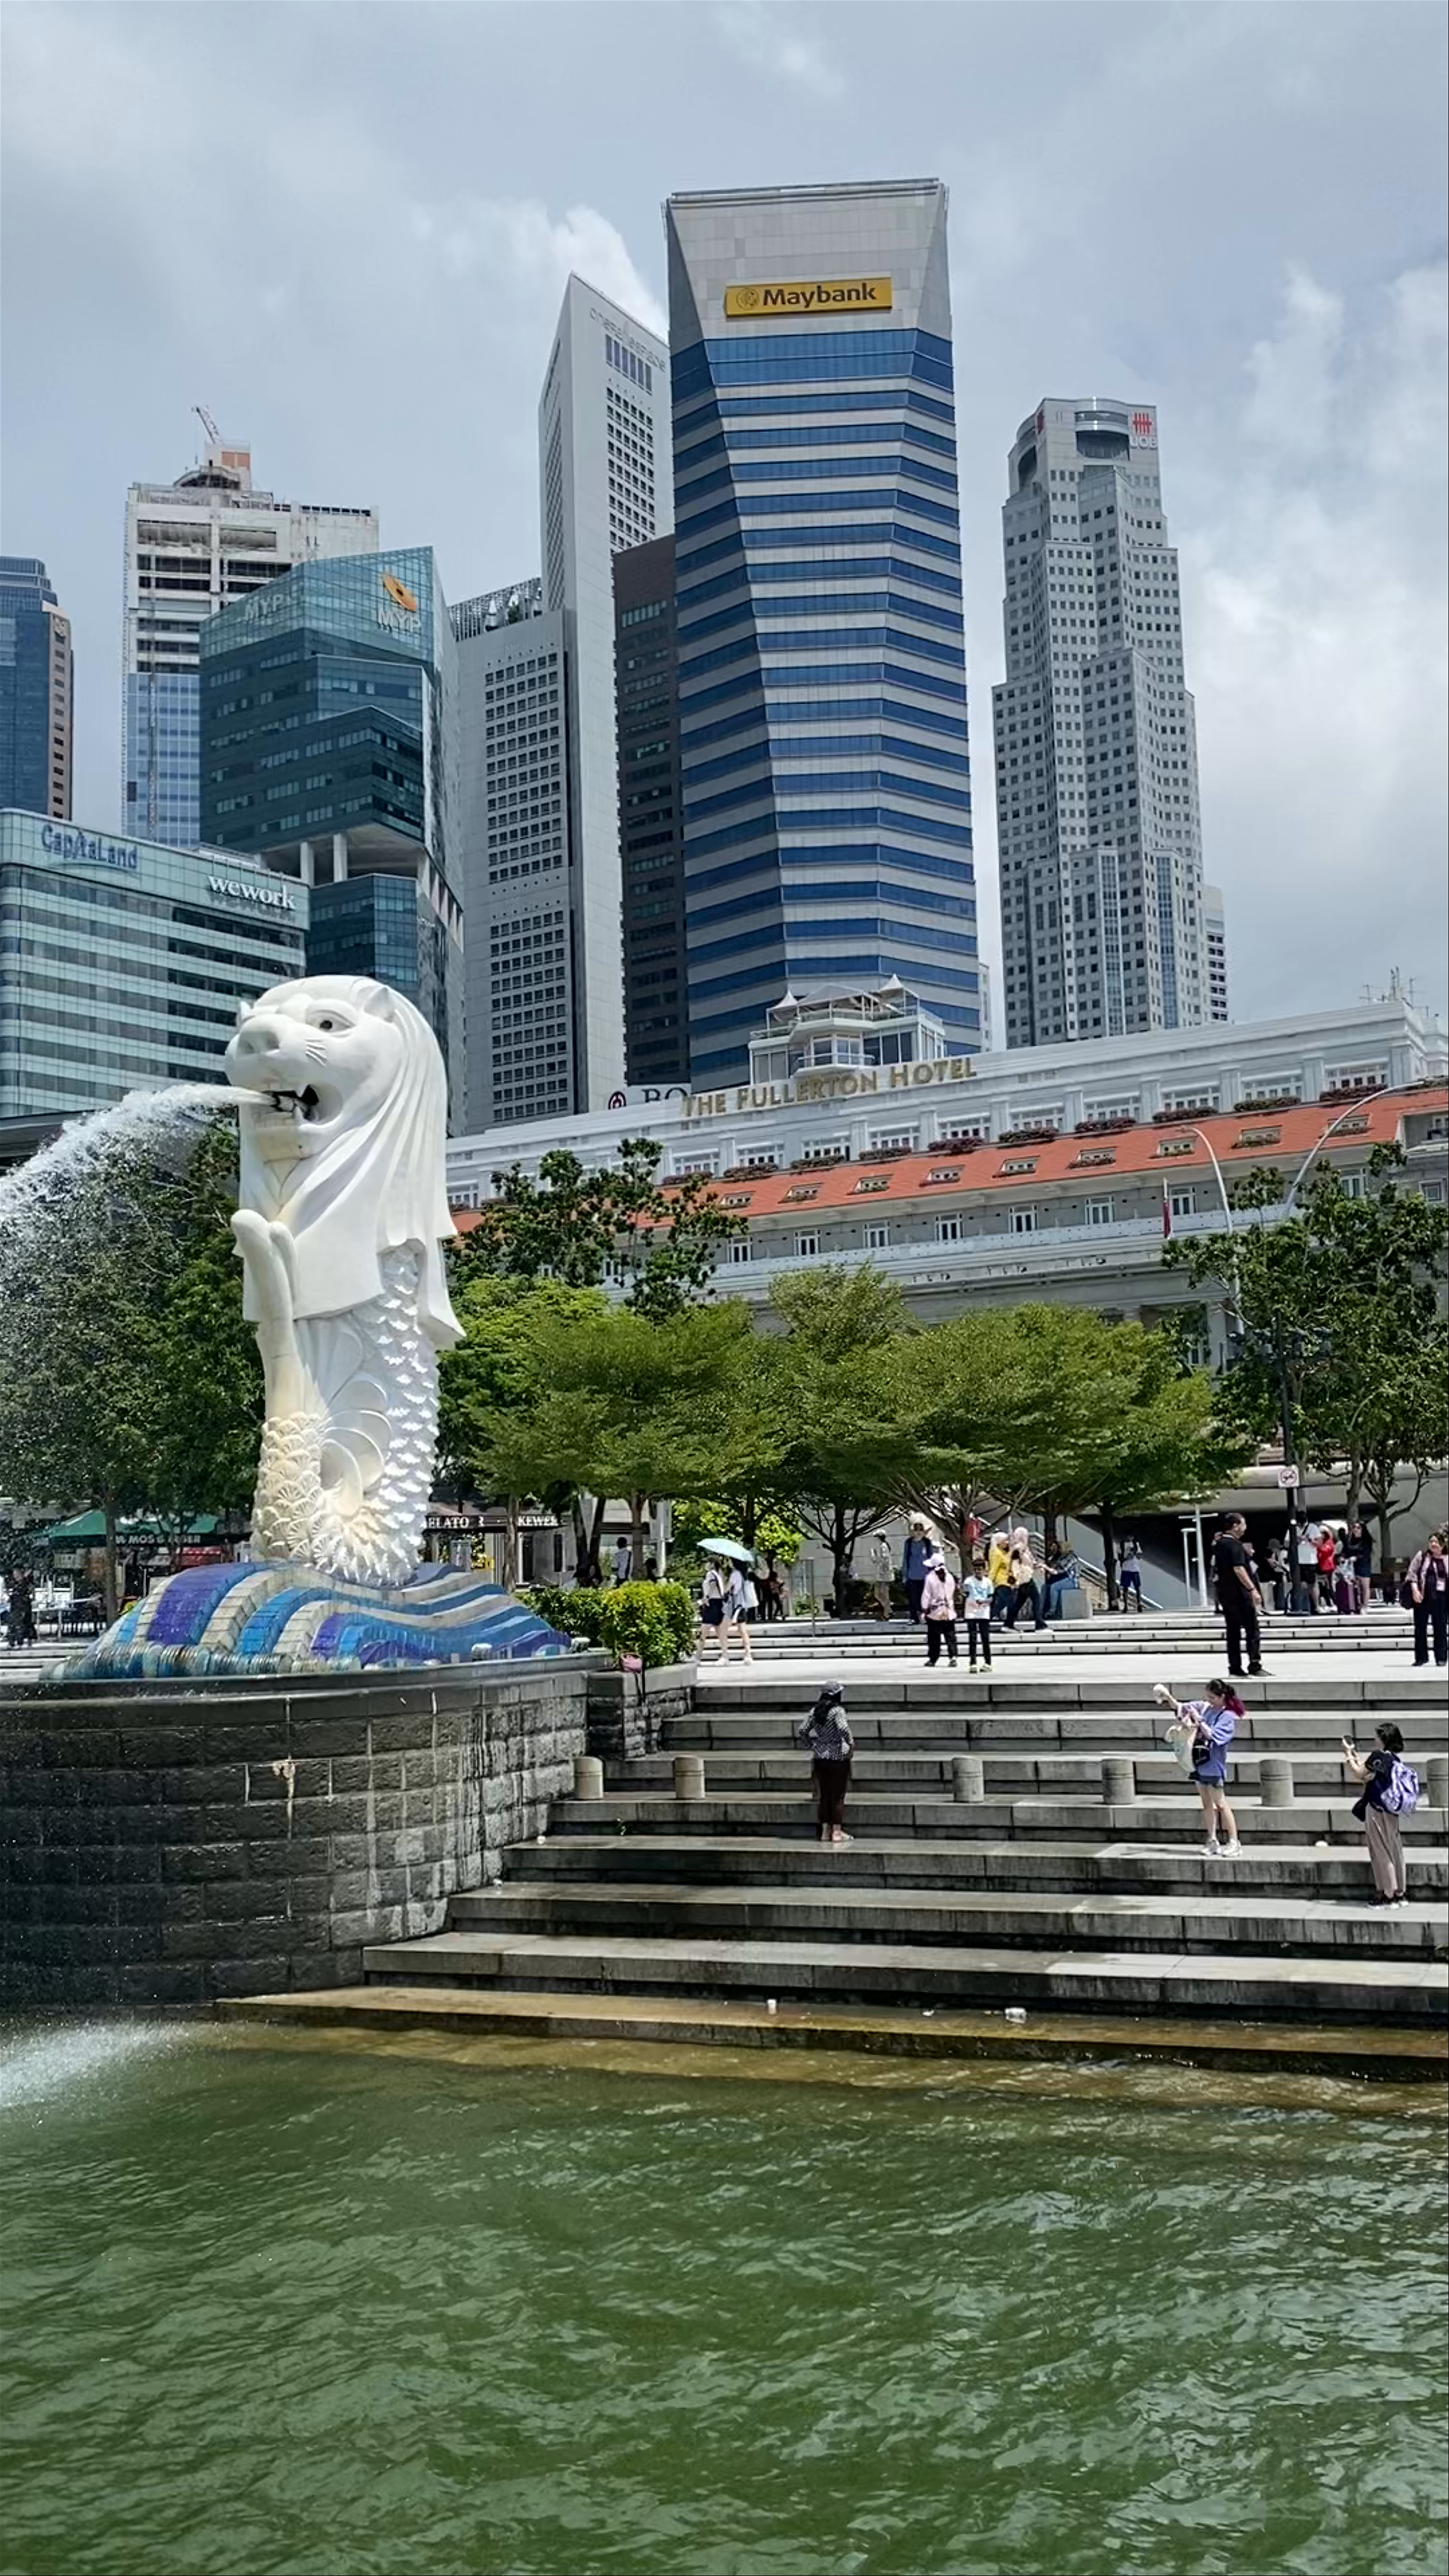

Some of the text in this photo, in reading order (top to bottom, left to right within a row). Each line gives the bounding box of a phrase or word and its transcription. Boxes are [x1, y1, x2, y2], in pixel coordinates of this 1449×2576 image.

[763, 282, 877, 309] Maybank
[1129, 436, 1158, 449] UOB
[245, 594, 283, 621] MYP
[378, 609, 421, 633] MYP
[41, 824, 137, 869] CapitaLand
[208, 875, 296, 909] wework
[682, 1057, 977, 1117] THE FULLERTON HOTEL
[128, 1534, 154, 1544] MOS
